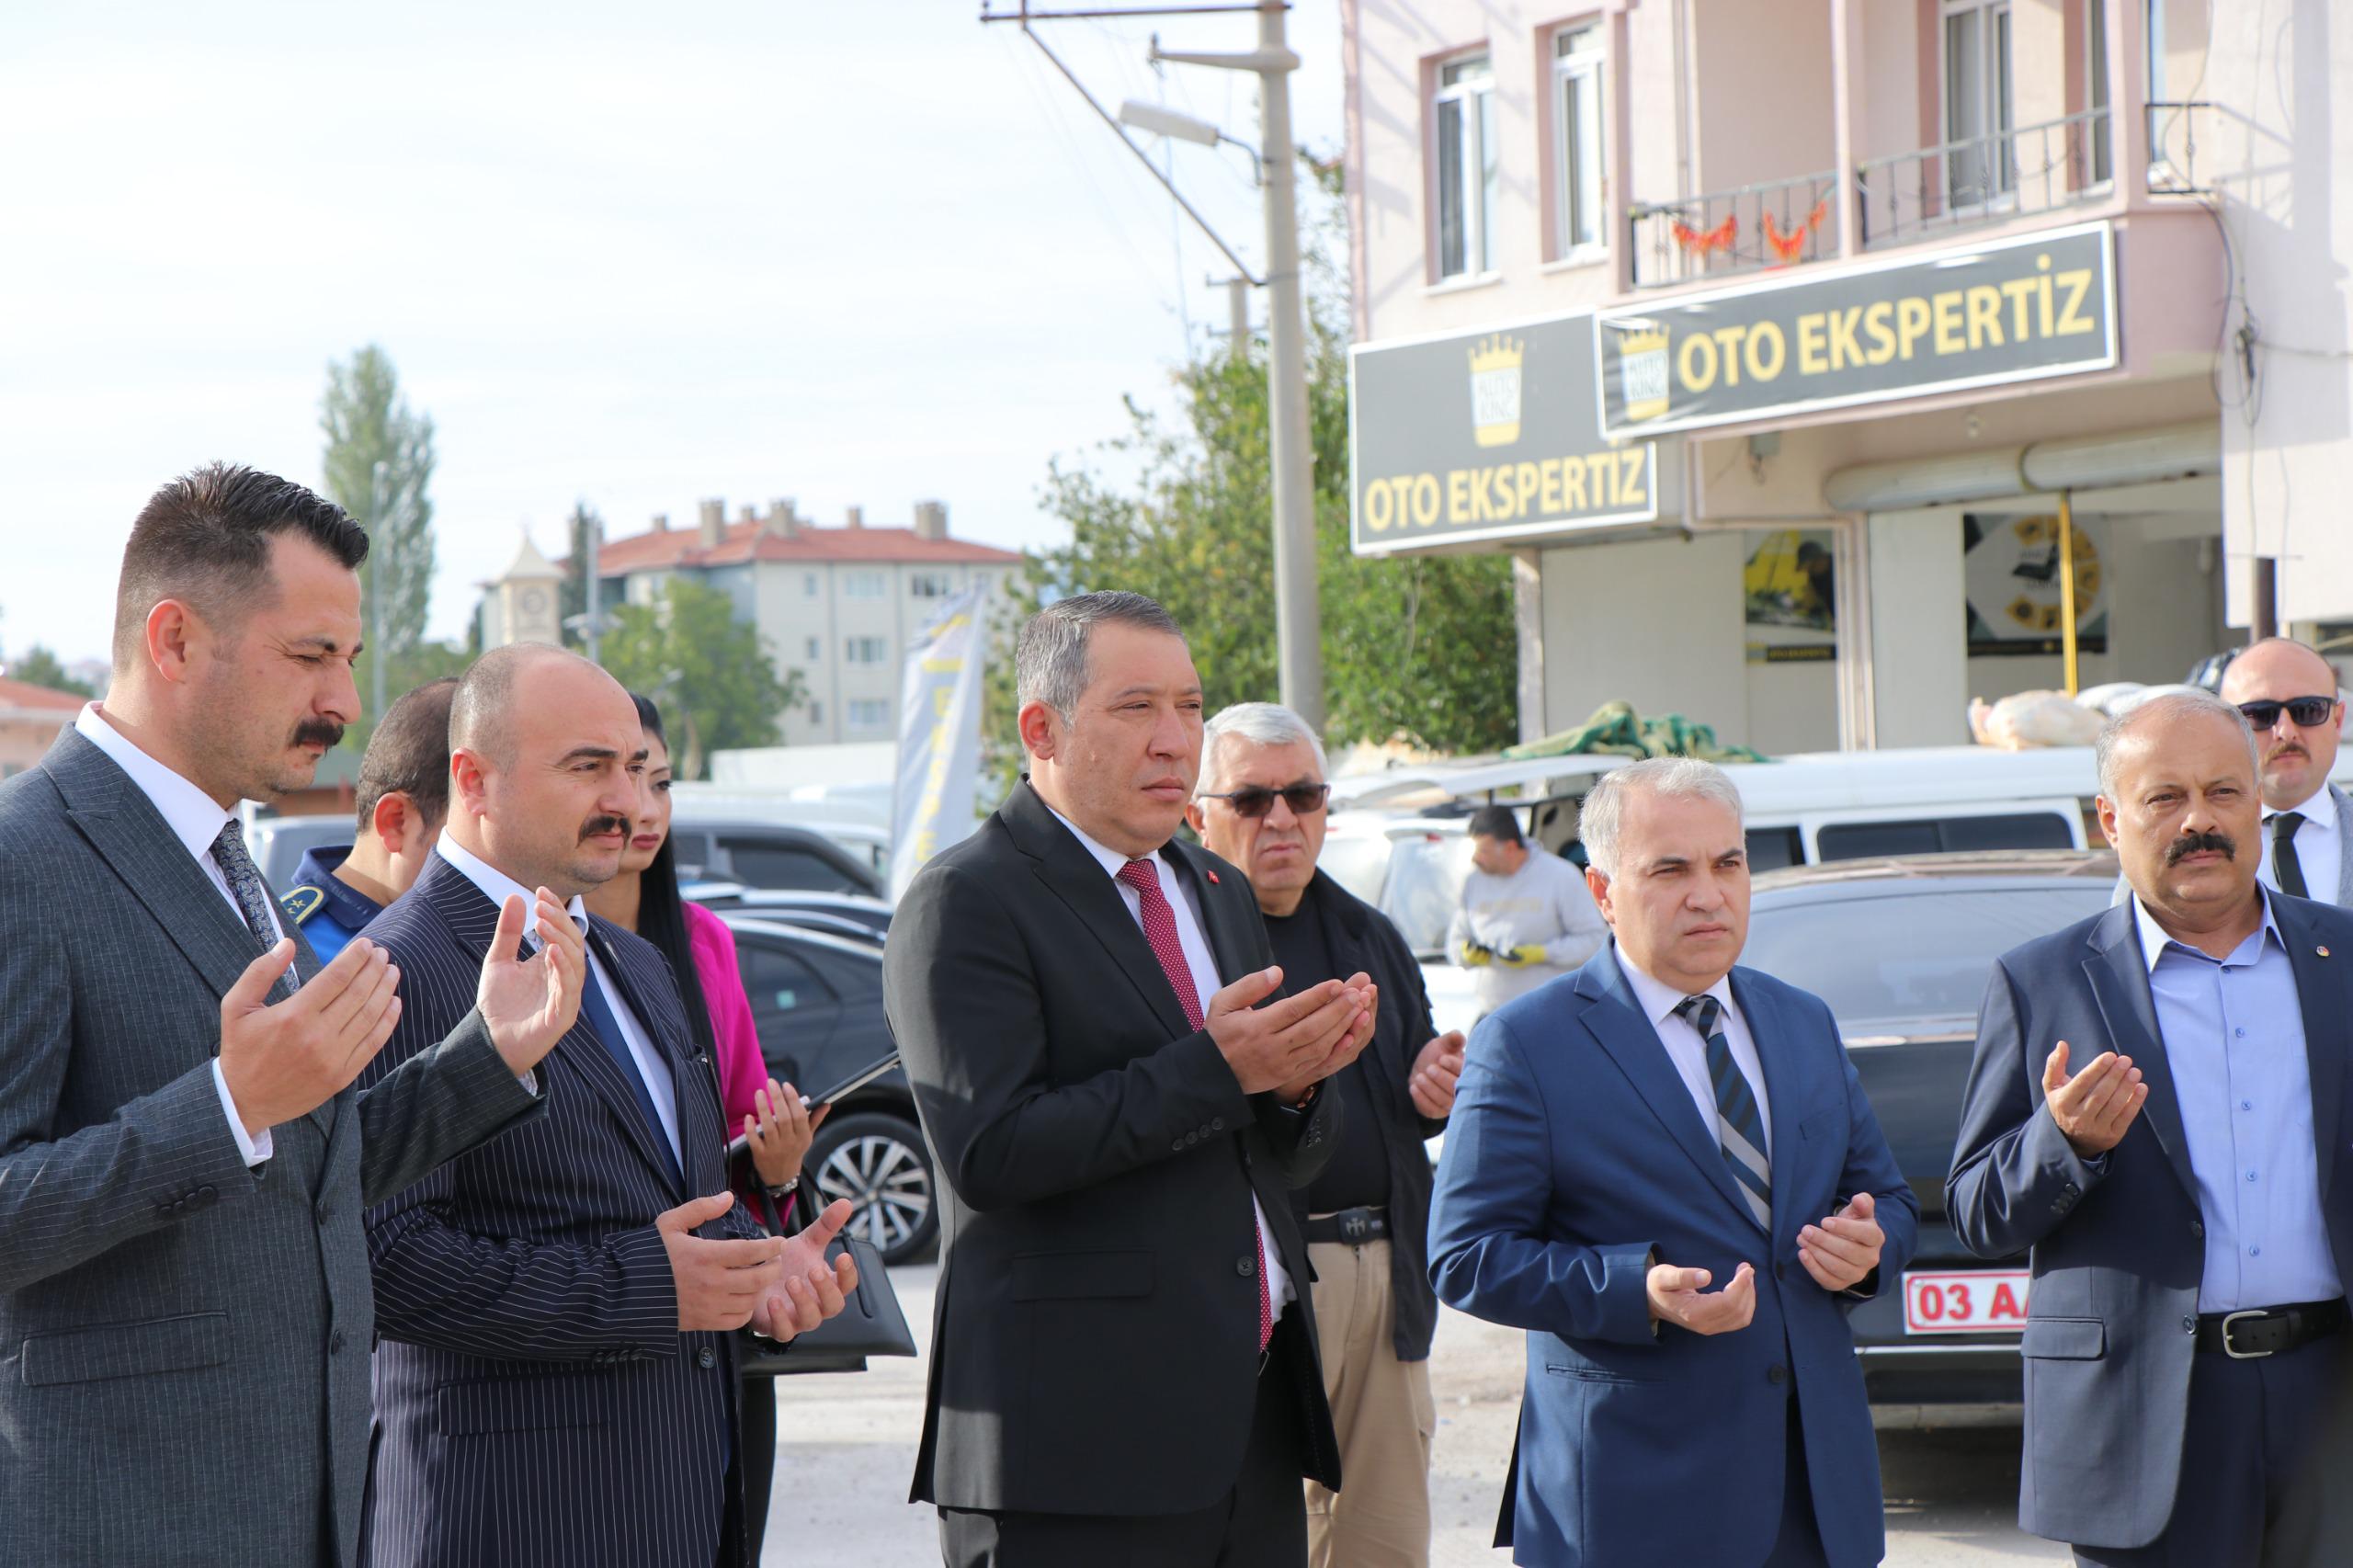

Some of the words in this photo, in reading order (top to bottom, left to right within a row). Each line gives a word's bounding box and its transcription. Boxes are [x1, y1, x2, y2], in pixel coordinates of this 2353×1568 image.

[1677, 320, 1786, 393] OTO
[1796, 254, 2096, 375] EKSPERTİZ
[1364, 472, 1441, 533] OTO
[1448, 437, 1647, 524] EKSPERTİZ
[1919, 1283, 1972, 1322] 03
[1988, 1282, 2029, 1320] A
